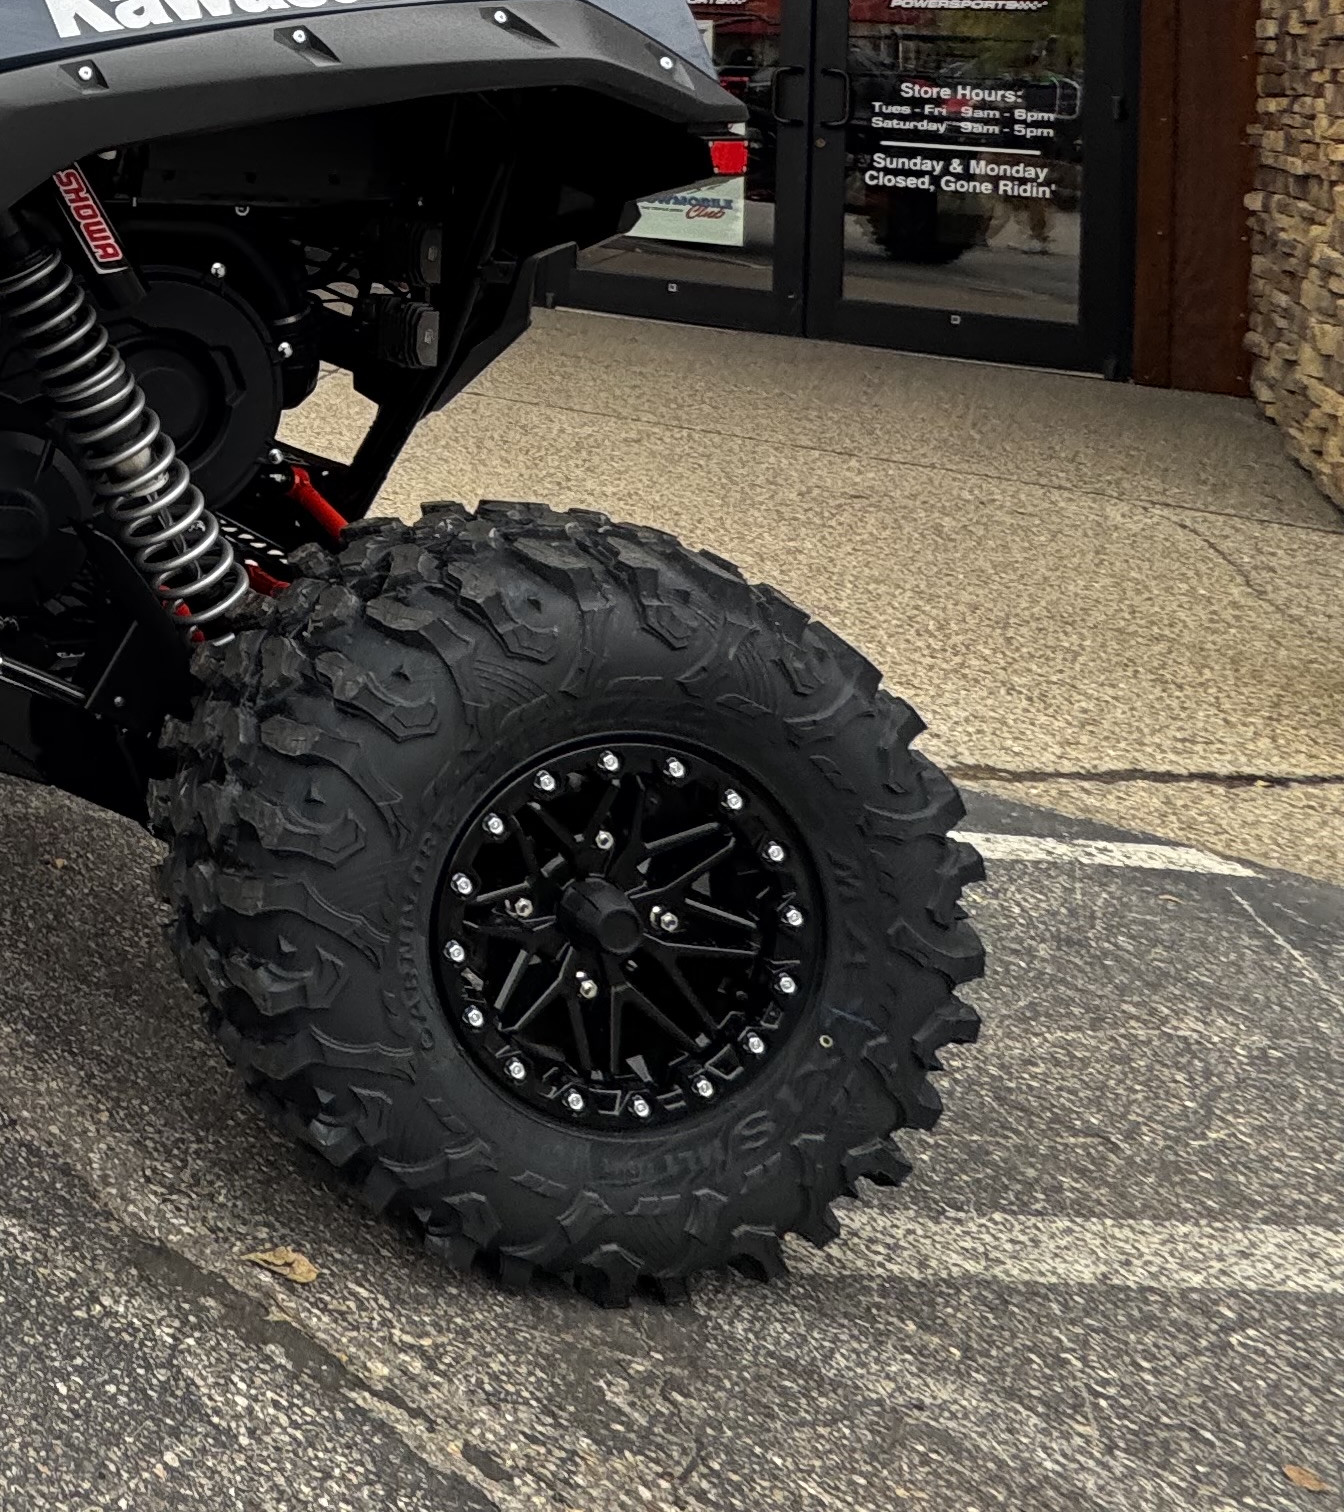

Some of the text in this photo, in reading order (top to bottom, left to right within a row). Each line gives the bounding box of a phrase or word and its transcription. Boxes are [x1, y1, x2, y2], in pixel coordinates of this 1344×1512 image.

[890, 0, 1021, 9] POWERSPORTS
[900, 83, 1024, 103] Store Hours:
[872, 102, 911, 114] Tues
[924, 105, 947, 116] Fri
[960, 106, 1000, 118] 9am
[1014, 109, 1055, 123] 6pm
[871, 117, 946, 134] Saturday
[960, 121, 1000, 134] 9am
[1013, 124, 1054, 138] 5pm
[872, 153, 1049, 180] Sunday & Monday
[864, 170, 1056, 199] Closed, Gone Ridin'
[52, 169, 123, 262] SHOWA
[685, 205, 726, 219] Club
